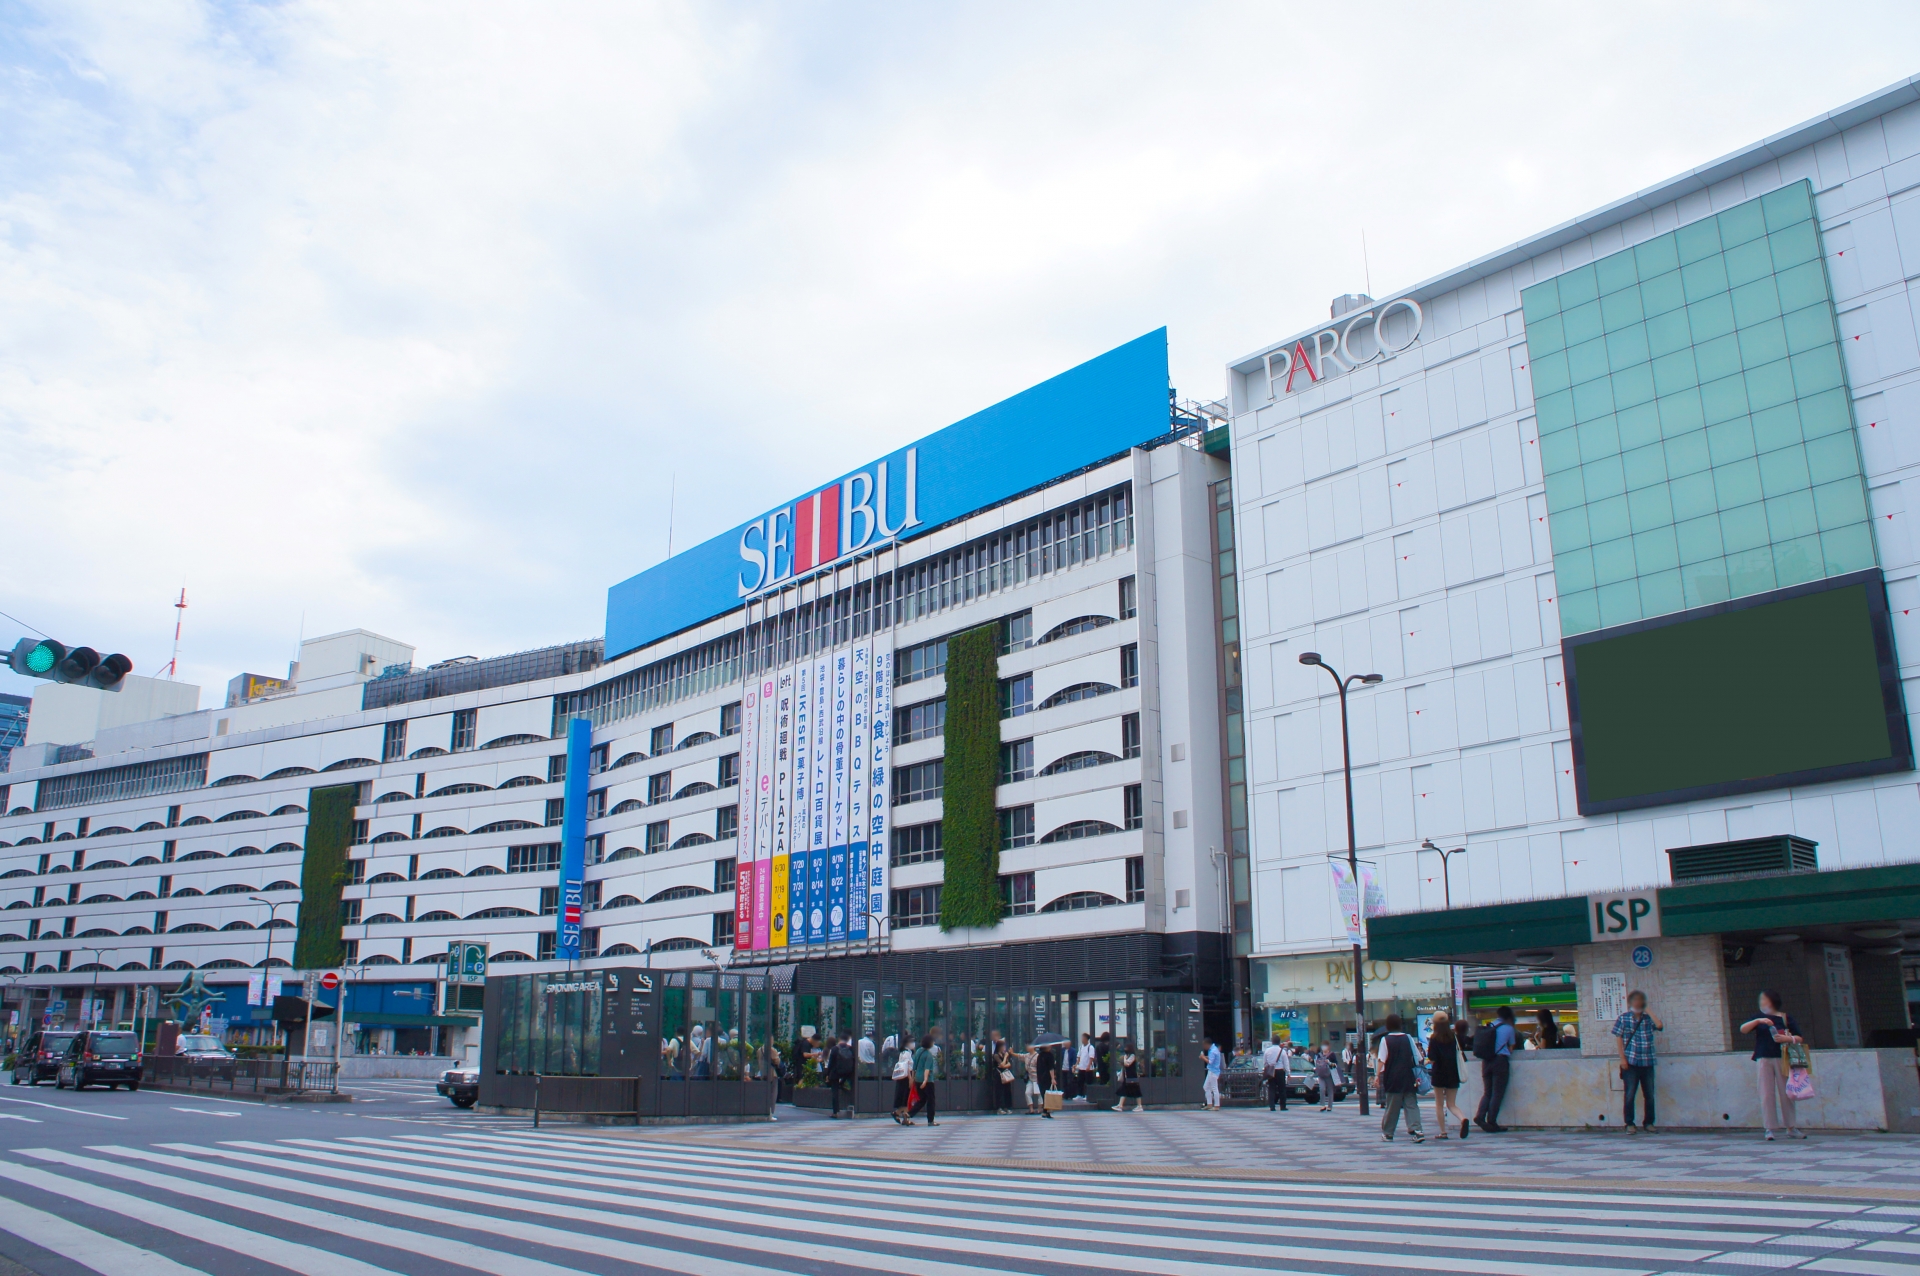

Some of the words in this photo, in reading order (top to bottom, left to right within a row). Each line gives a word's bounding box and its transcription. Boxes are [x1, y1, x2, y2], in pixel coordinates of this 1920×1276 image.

[1262, 298, 1423, 401] PARCO
[738, 447, 924, 598] SEIBU
[777, 772, 786, 852] PLAZA
[564, 879, 583, 947] SEIBU
[1595, 898, 1651, 934] ISP
[1635, 950, 1650, 963] 28
[53, 1001, 65, 1012] P
[546, 982, 579, 994] SMOKING
[579, 981, 600, 991] AREA
